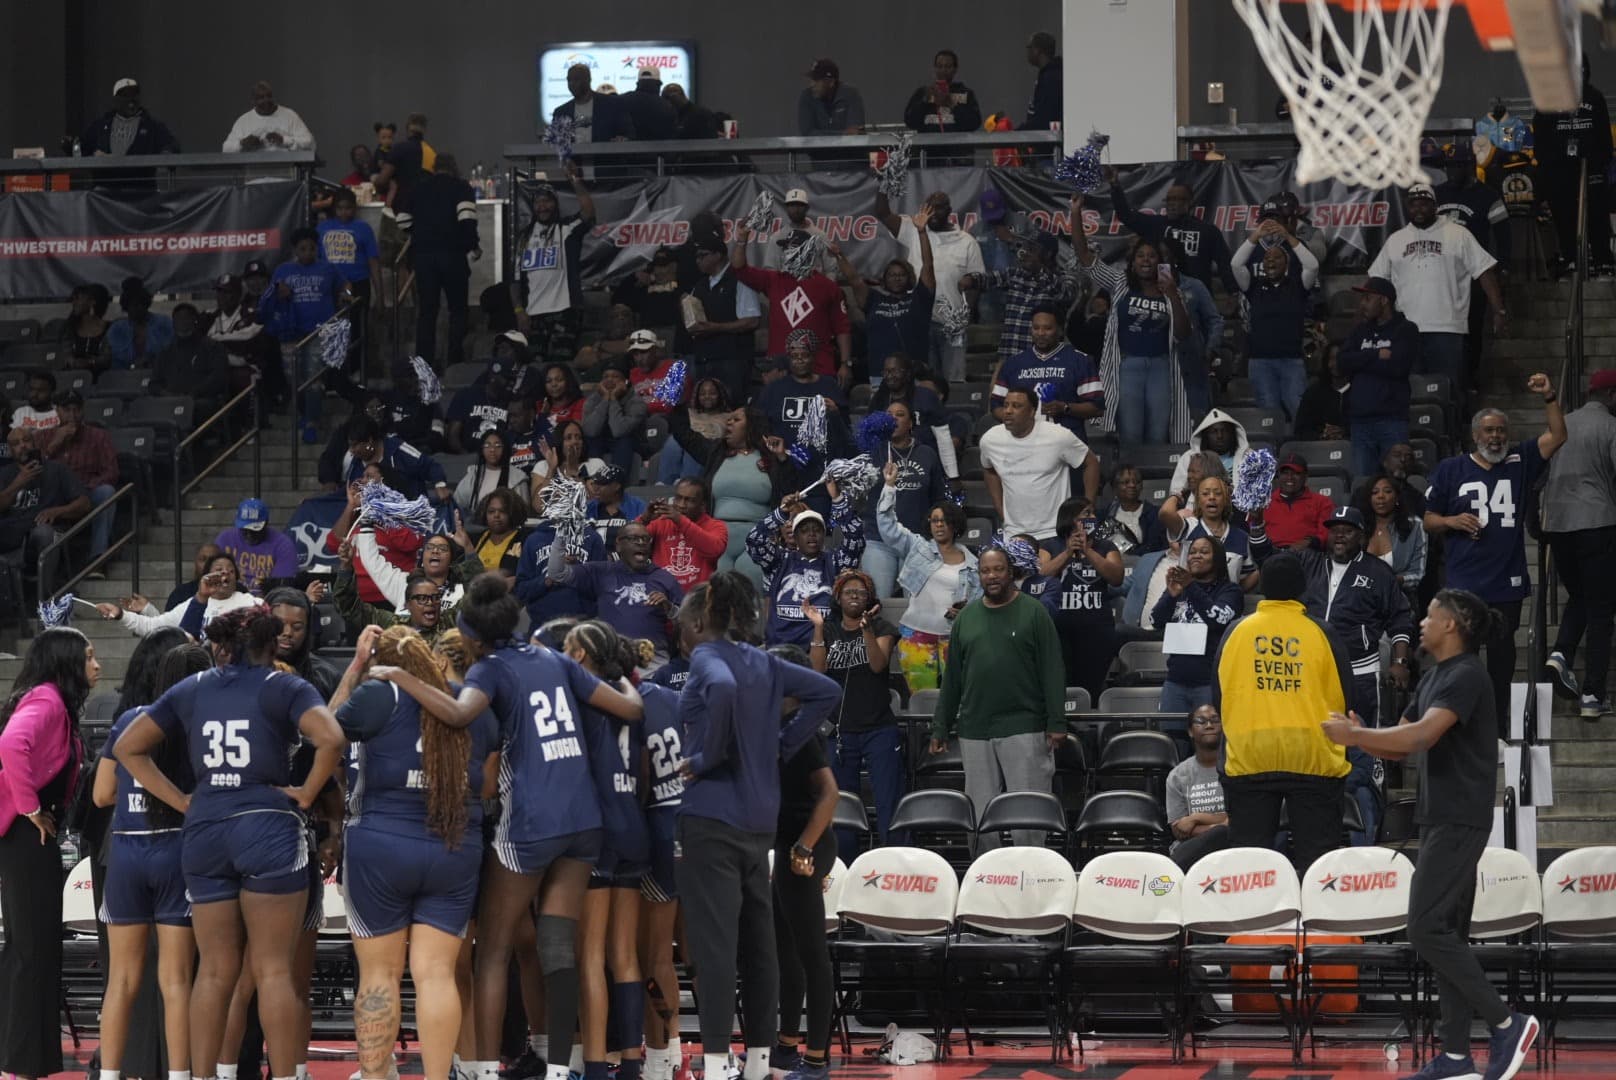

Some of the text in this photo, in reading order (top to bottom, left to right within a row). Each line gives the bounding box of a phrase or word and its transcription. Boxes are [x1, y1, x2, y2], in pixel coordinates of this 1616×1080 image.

[636, 55, 680, 70] SWAC
[1312, 202, 1391, 228] SWAC
[91, 236, 164, 252] ATHLETIC
[167, 232, 267, 250] CONFERENCE
[615, 221, 690, 247] SWAC
[1128, 296, 1168, 313] TIGER
[1018, 366, 1067, 380] JACKSON STATE
[470, 405, 509, 423] JACKSON
[1336, 506, 1348, 517] J
[1458, 479, 1517, 529] 34
[1073, 584, 1091, 592] MY
[776, 607, 805, 619] ACKSON
[1254, 636, 1301, 658] CSC
[1254, 659, 1304, 676] EVENT
[1256, 677, 1302, 693] STAFF
[529, 686, 576, 737] 24
[202, 719, 251, 769] 35
[647, 726, 683, 779] 22
[1190, 789, 1216, 798] ABOUT
[1191, 804, 1215, 813] STUDY
[881, 874, 938, 893] SWAC
[986, 875, 1018, 886] SWAC
[1106, 877, 1140, 889] SWAC
[1219, 870, 1277, 893] SWAC
[1339, 871, 1397, 892] SWAC
[1578, 874, 1616, 893] SWA
